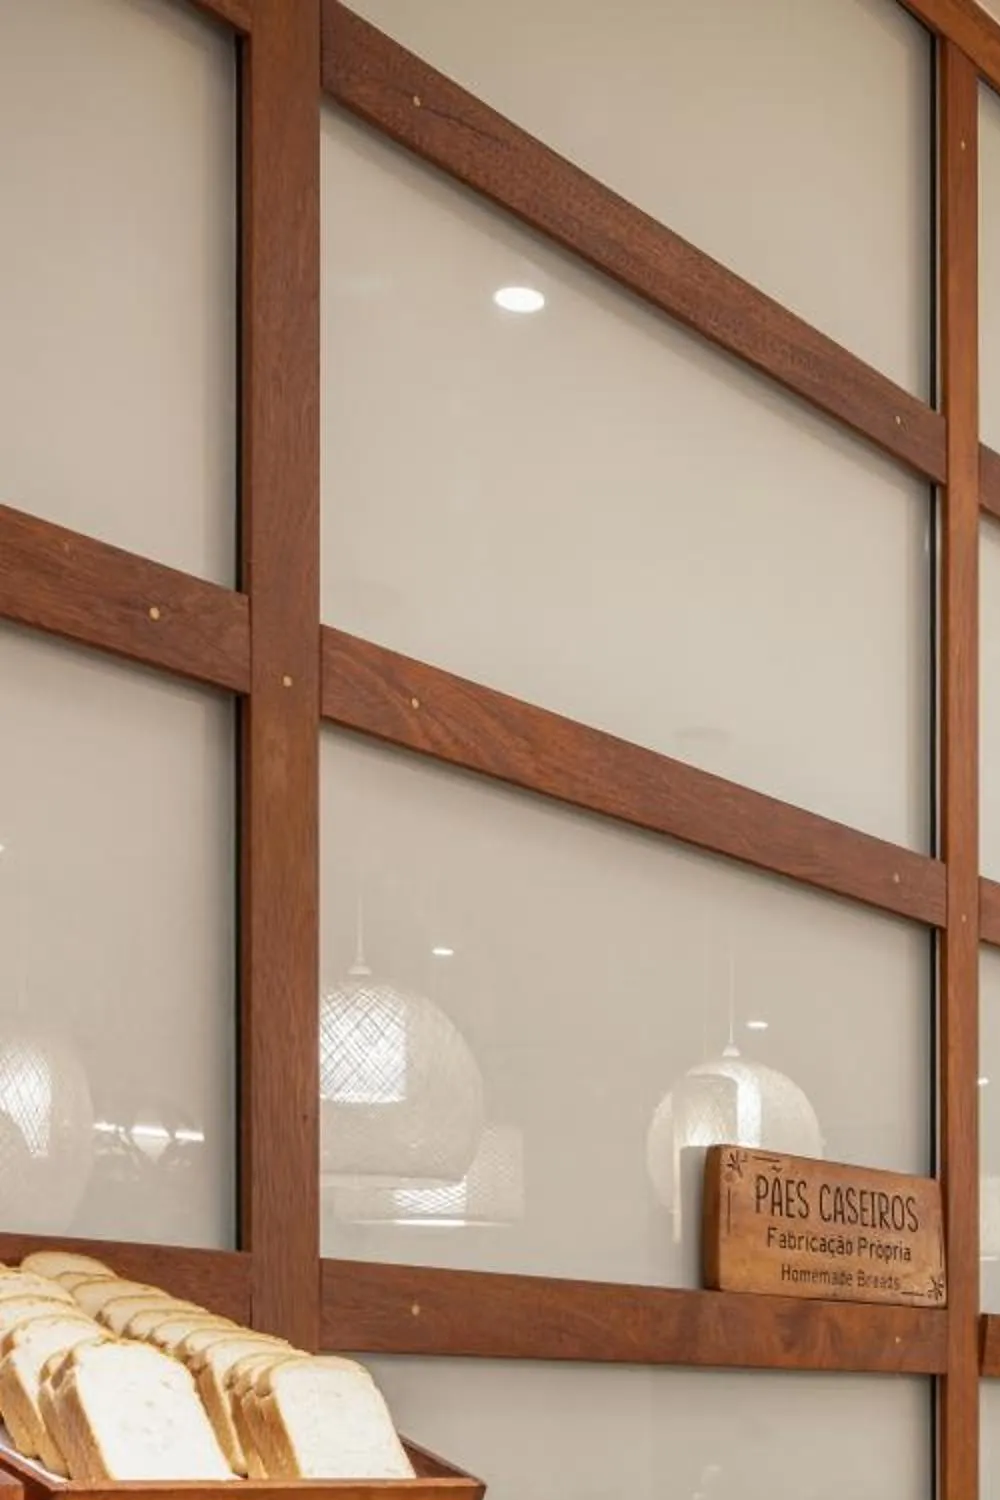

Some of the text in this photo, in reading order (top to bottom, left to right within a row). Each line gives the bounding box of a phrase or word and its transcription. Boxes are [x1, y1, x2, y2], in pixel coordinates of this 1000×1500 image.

[755, 1165, 919, 1233] PÃES CASEIROS
[767, 1226, 912, 1264] Fabricação Própria
[781, 1264, 853, 1287] Homemade
